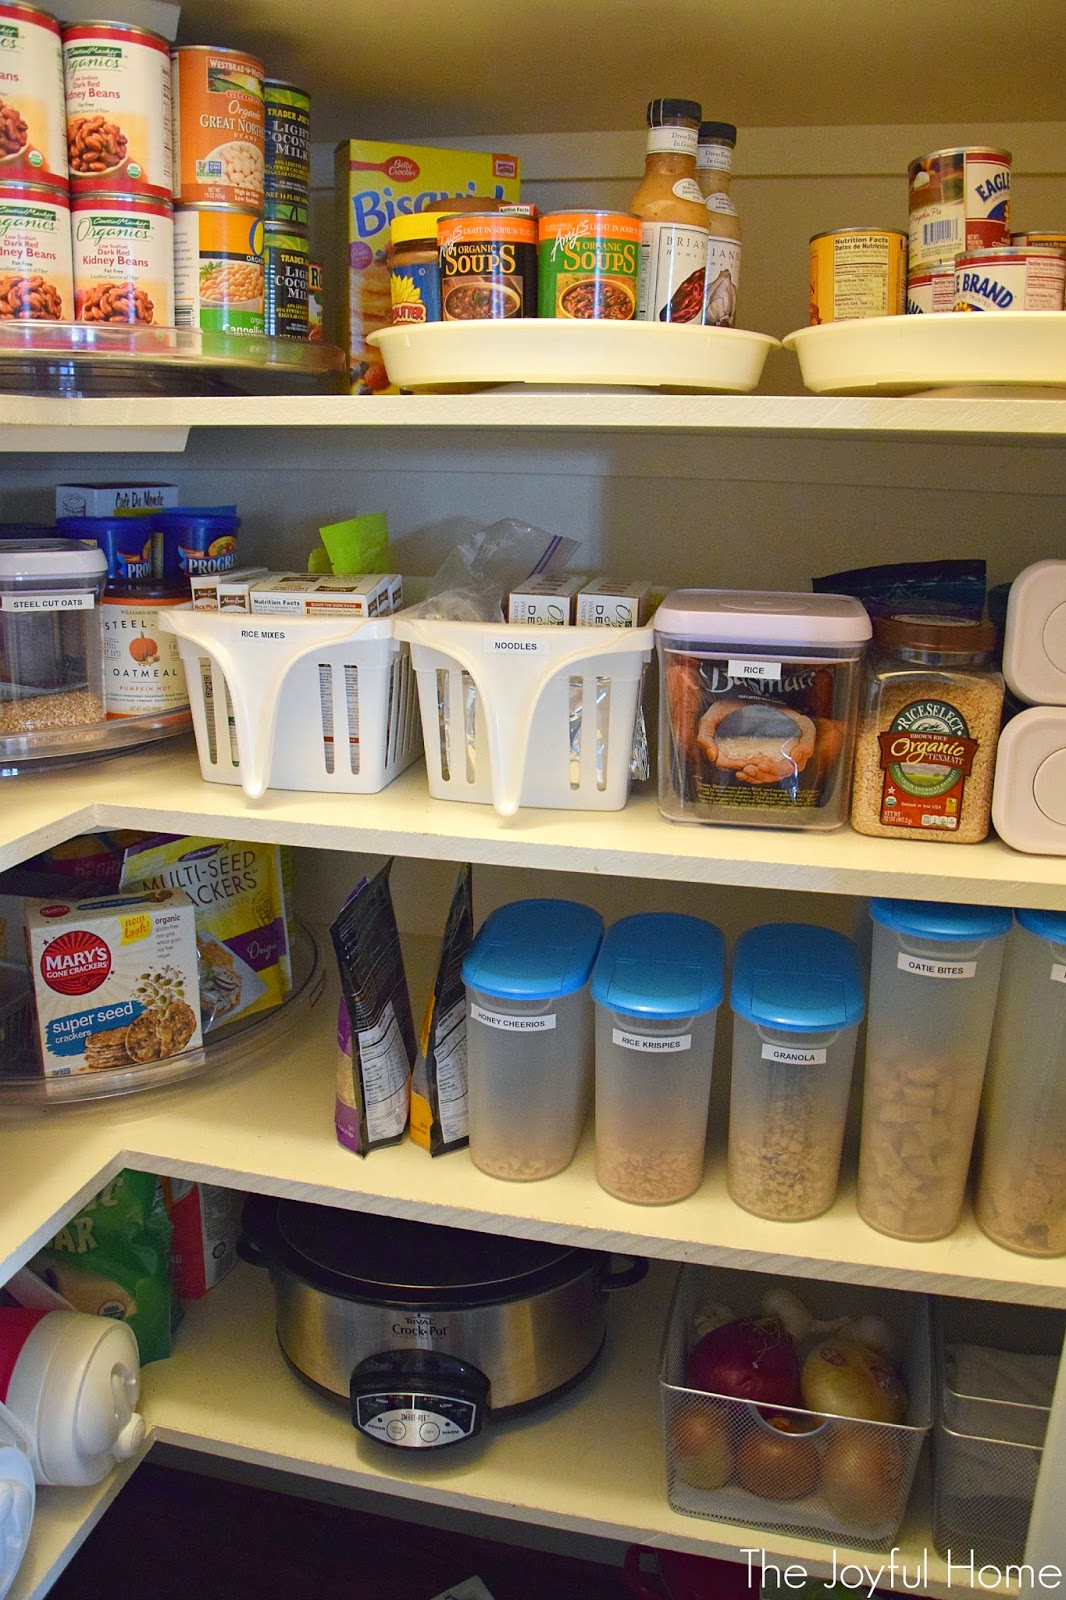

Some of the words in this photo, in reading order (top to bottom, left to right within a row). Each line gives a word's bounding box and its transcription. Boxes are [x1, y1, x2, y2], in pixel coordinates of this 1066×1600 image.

[210, 59, 245, 73] WESTBRAE
[88, 88, 120, 98] Beans
[267, 108, 296, 120] TRADER
[200, 114, 235, 130] GREAT
[394, 159, 413, 170] Betty
[388, 166, 416, 177] Crocker
[77, 218, 149, 246] Organics
[494, 227, 518, 235] SODIUM
[590, 224, 610, 232] LIGHT
[25, 240, 38, 248] Red
[551, 220, 591, 262] Amy's
[835, 236, 867, 244] Nutrition
[458, 245, 497, 254] ORGANIC
[582, 241, 622, 251] ORGANIC
[27, 249, 56, 260] Beans
[281, 254, 304, 265] TRADER
[445, 244, 516, 276] SOUPS
[563, 241, 635, 273] SOUPS
[83, 256, 115, 267] Kidney
[118, 257, 149, 267] Beans
[962, 273, 1014, 309] BRAND
[132, 492, 142, 507] Du
[13, 600, 41, 608] STEEL
[42, 600, 59, 608] CUT
[61, 599, 83, 607] OATS
[241, 630, 259, 638] RICE
[261, 631, 285, 639] MIXES
[495, 641, 537, 650] NOODLES
[112, 668, 178, 677] OATMEAL
[743, 666, 765, 674] RICE
[891, 738, 964, 764] Organic
[125, 915, 145, 927] new
[155, 914, 181, 925] organic
[124, 921, 149, 938] look!
[156, 931, 175, 939] non-gmo
[45, 946, 108, 971] MARY'S
[46, 971, 68, 979] GONE
[69, 961, 108, 975] CRACKERS
[908, 961, 934, 973] OATIE
[937, 966, 964, 975] BITES
[52, 1014, 95, 1034] super
[97, 1001, 133, 1022] seed
[477, 1012, 501, 1025] HONEY
[503, 1019, 545, 1028] CHEERIOS
[55, 1029, 92, 1044] crackers
[622, 1036, 640, 1047] RICE
[642, 1041, 681, 1049] KRISPIES
[773, 1051, 815, 1062] GRANOLA
